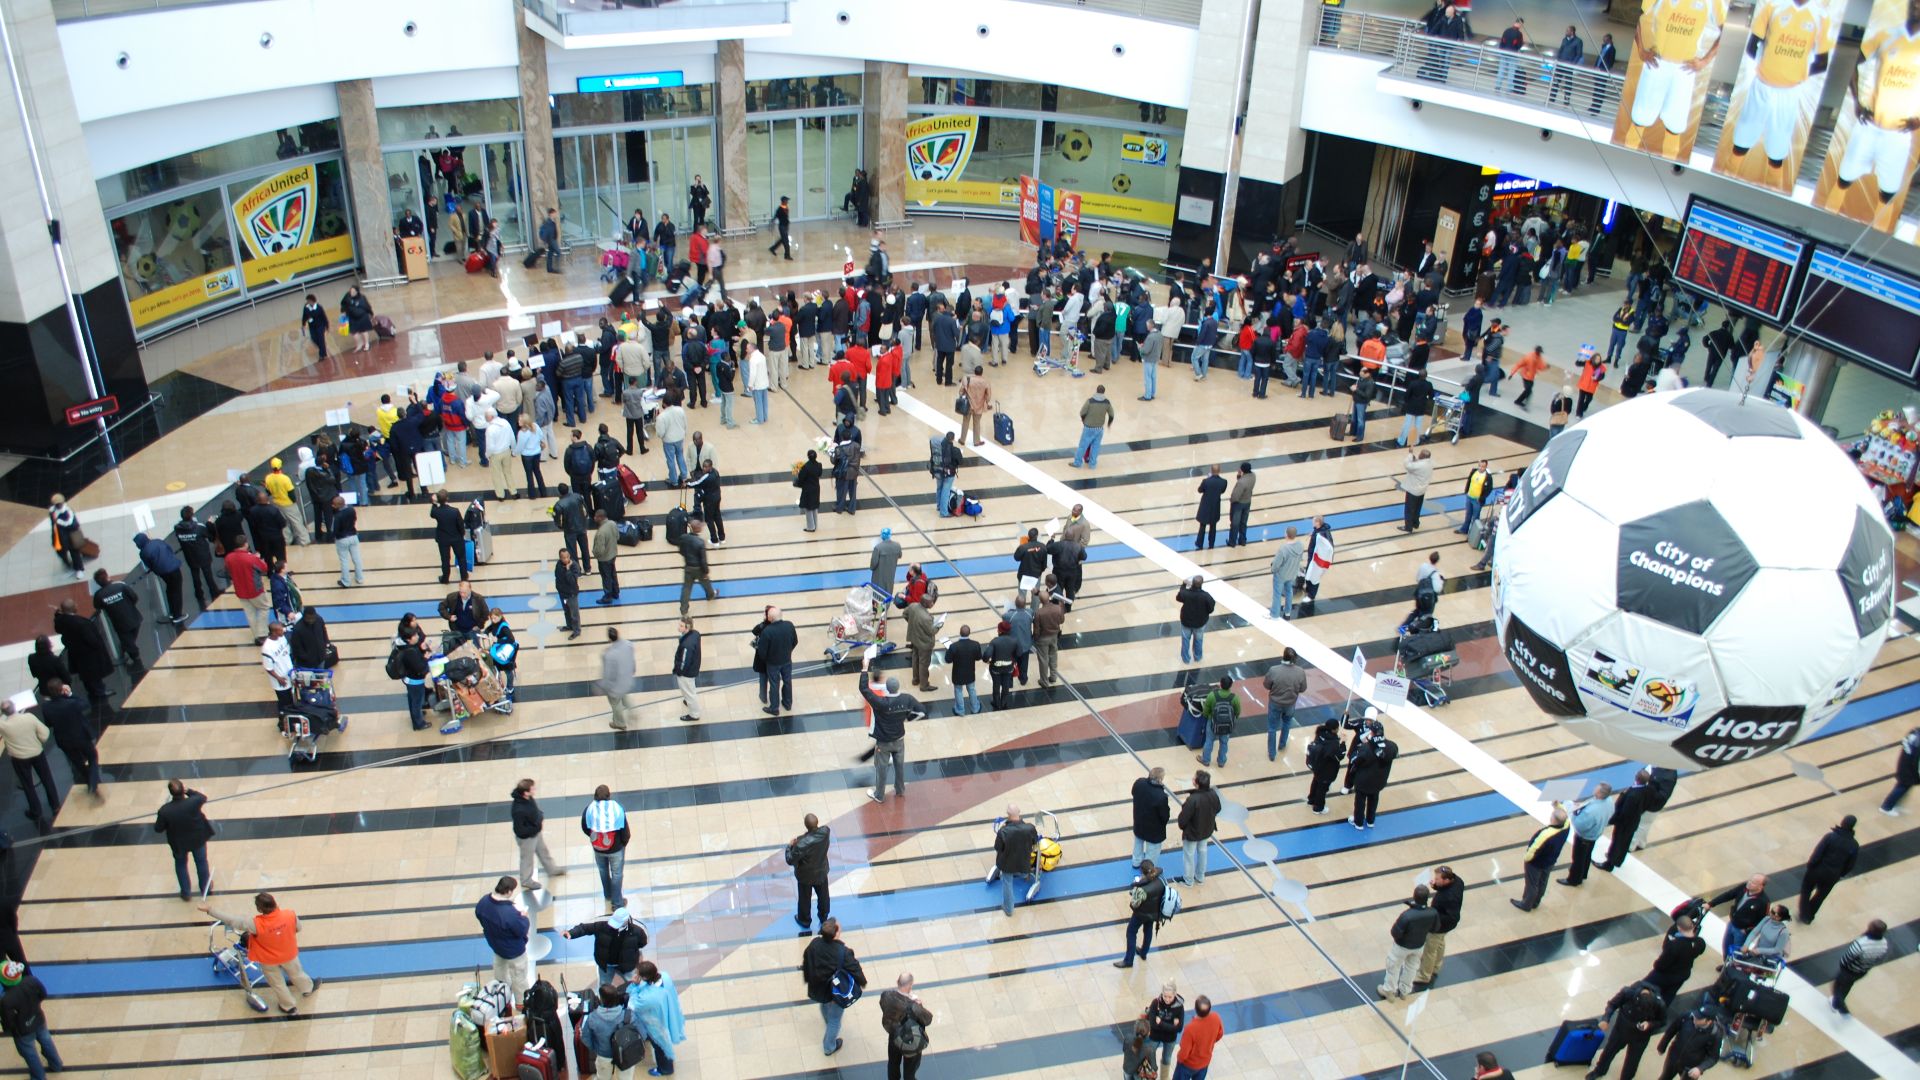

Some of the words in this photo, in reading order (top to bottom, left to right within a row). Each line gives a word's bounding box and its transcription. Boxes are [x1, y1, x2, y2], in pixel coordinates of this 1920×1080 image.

[1668, 12, 1696, 26] Africa
[1665, 23, 1696, 36] United
[1778, 33, 1807, 48] Africa
[1774, 45, 1805, 59] United
[1655, 541, 1690, 566] City
[1690, 557, 1715, 573] of
[1630, 550, 1723, 596] Champions
[1514, 638, 1537, 667] City
[1539, 663, 1556, 680] of
[1509, 647, 1566, 702] Tshwane
[1705, 717, 1797, 740] HOST
[1695, 744, 1767, 761] CITY
